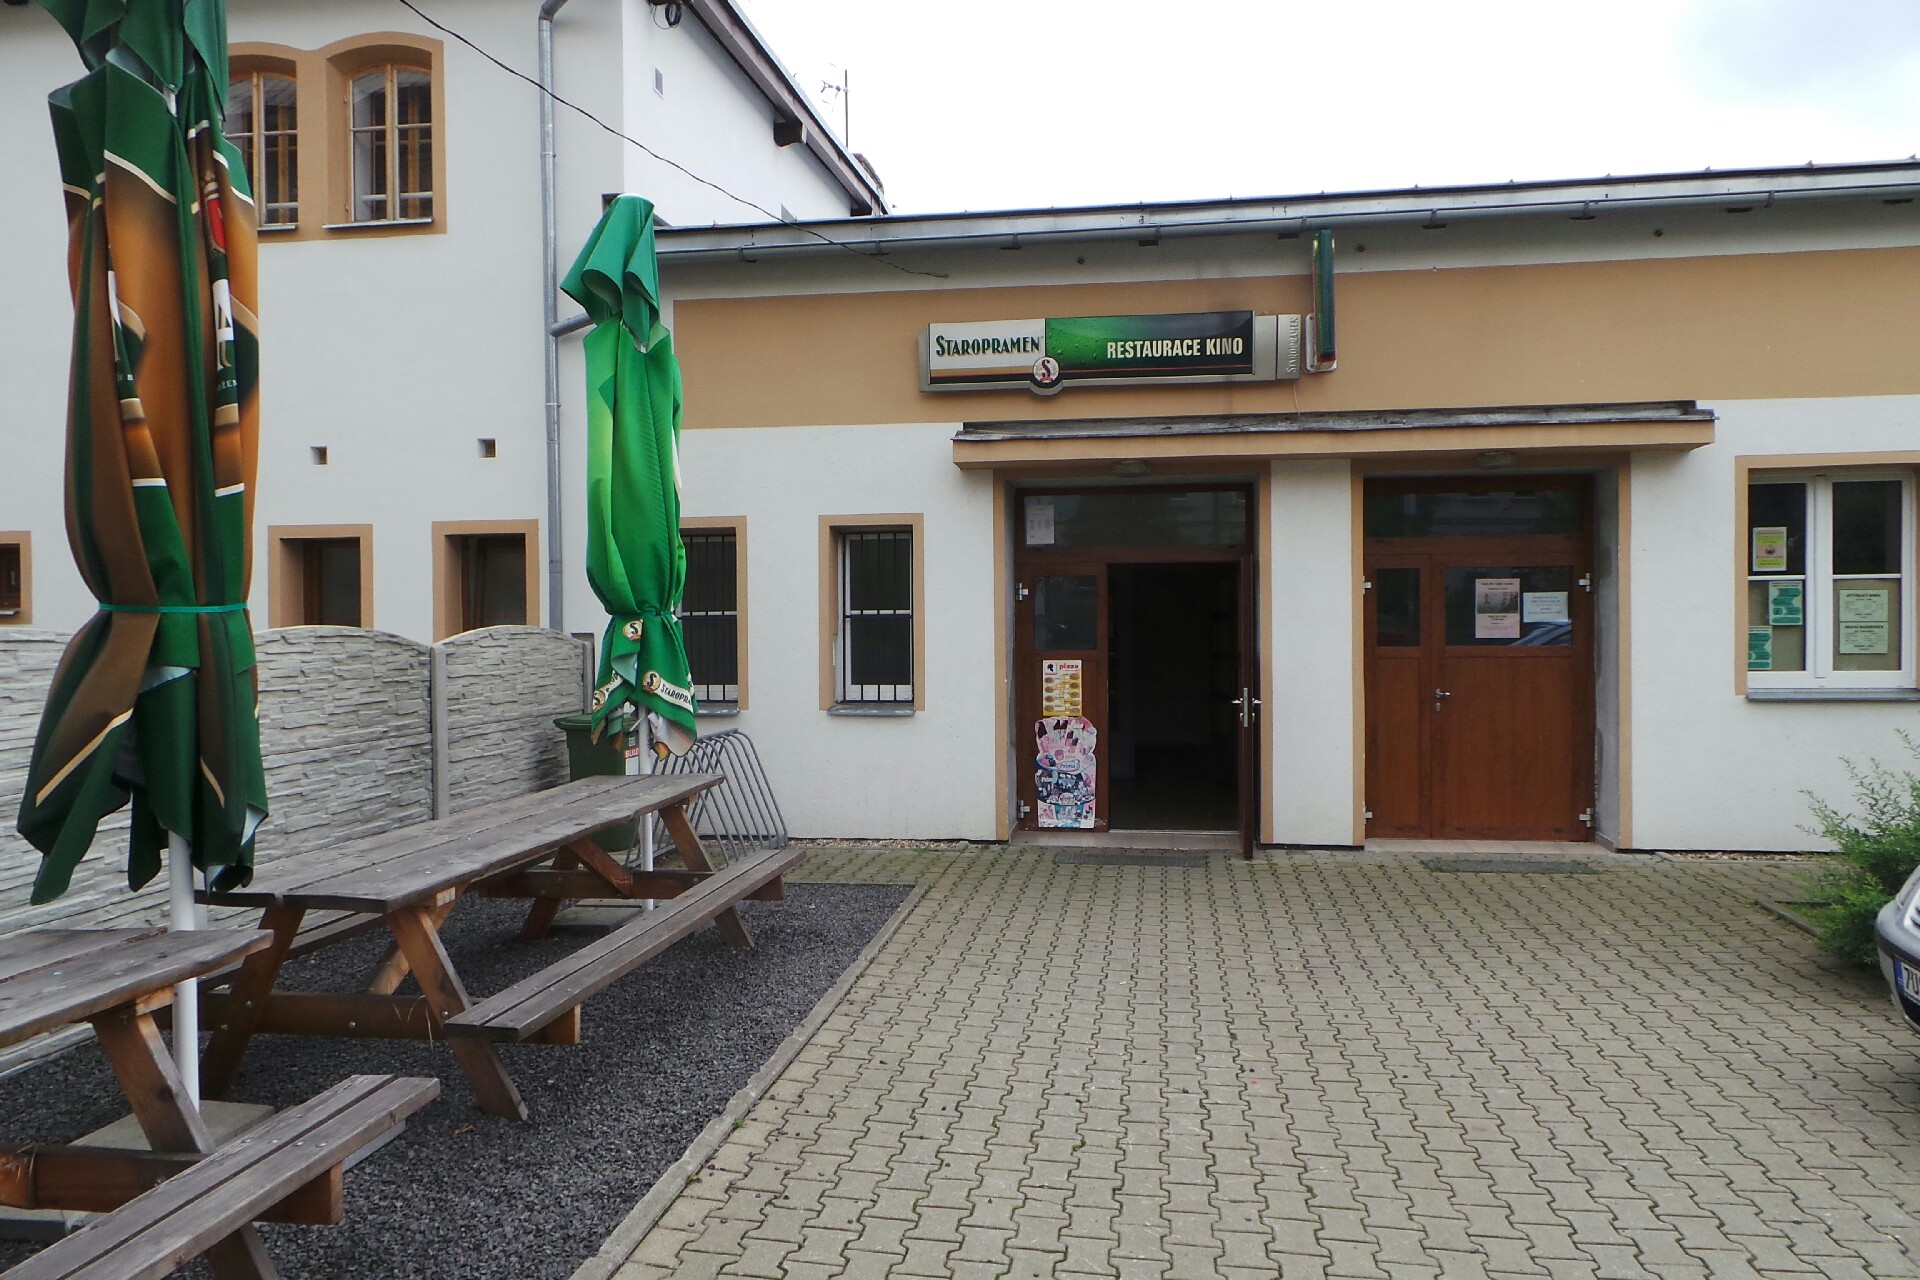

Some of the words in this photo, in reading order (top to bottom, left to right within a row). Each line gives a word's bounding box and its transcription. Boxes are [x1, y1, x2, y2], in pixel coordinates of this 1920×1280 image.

[936, 335, 1040, 356] STAROPRAMEN
[1107, 339, 1201, 358] RESTAURACE
[1206, 337, 1243, 355] KINO
[1903, 966, 1920, 996] 7U
